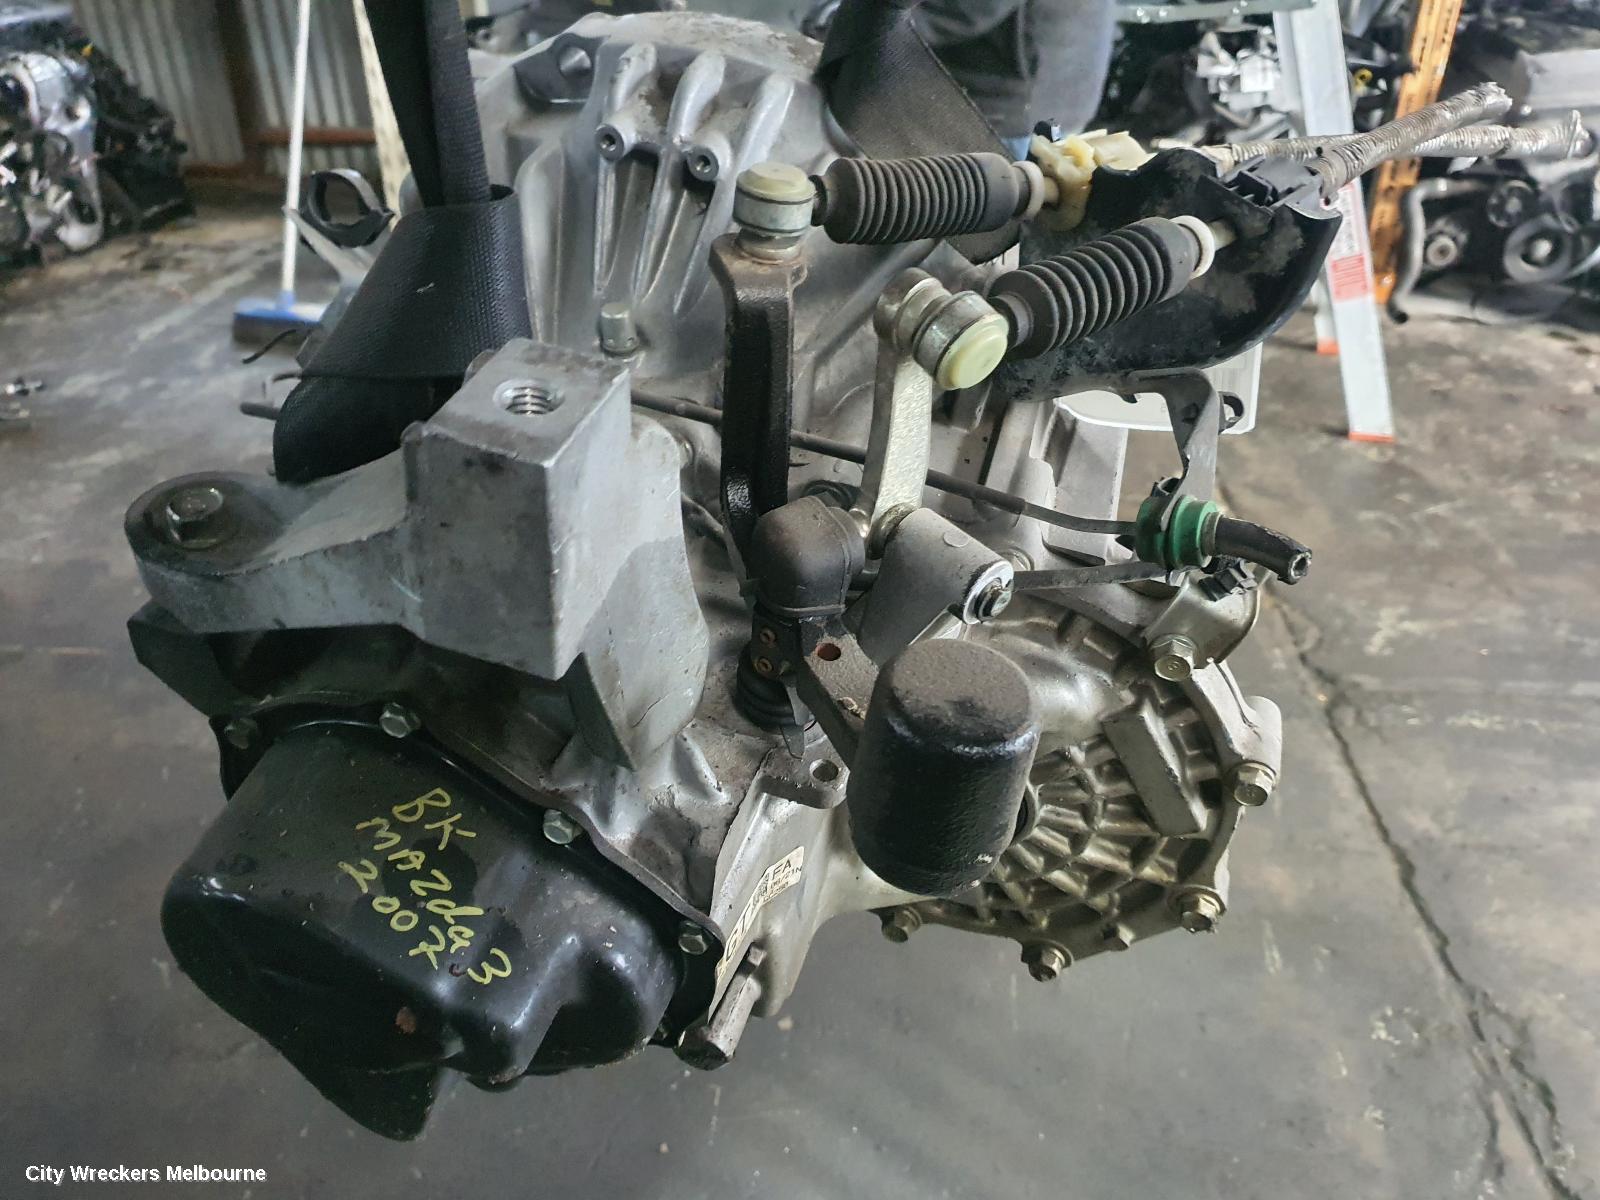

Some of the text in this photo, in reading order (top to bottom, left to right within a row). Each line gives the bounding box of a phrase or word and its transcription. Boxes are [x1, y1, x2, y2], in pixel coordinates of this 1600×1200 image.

[391, 787, 477, 850] BK
[338, 859, 446, 971] 2007
[467, 947, 512, 984] 3
